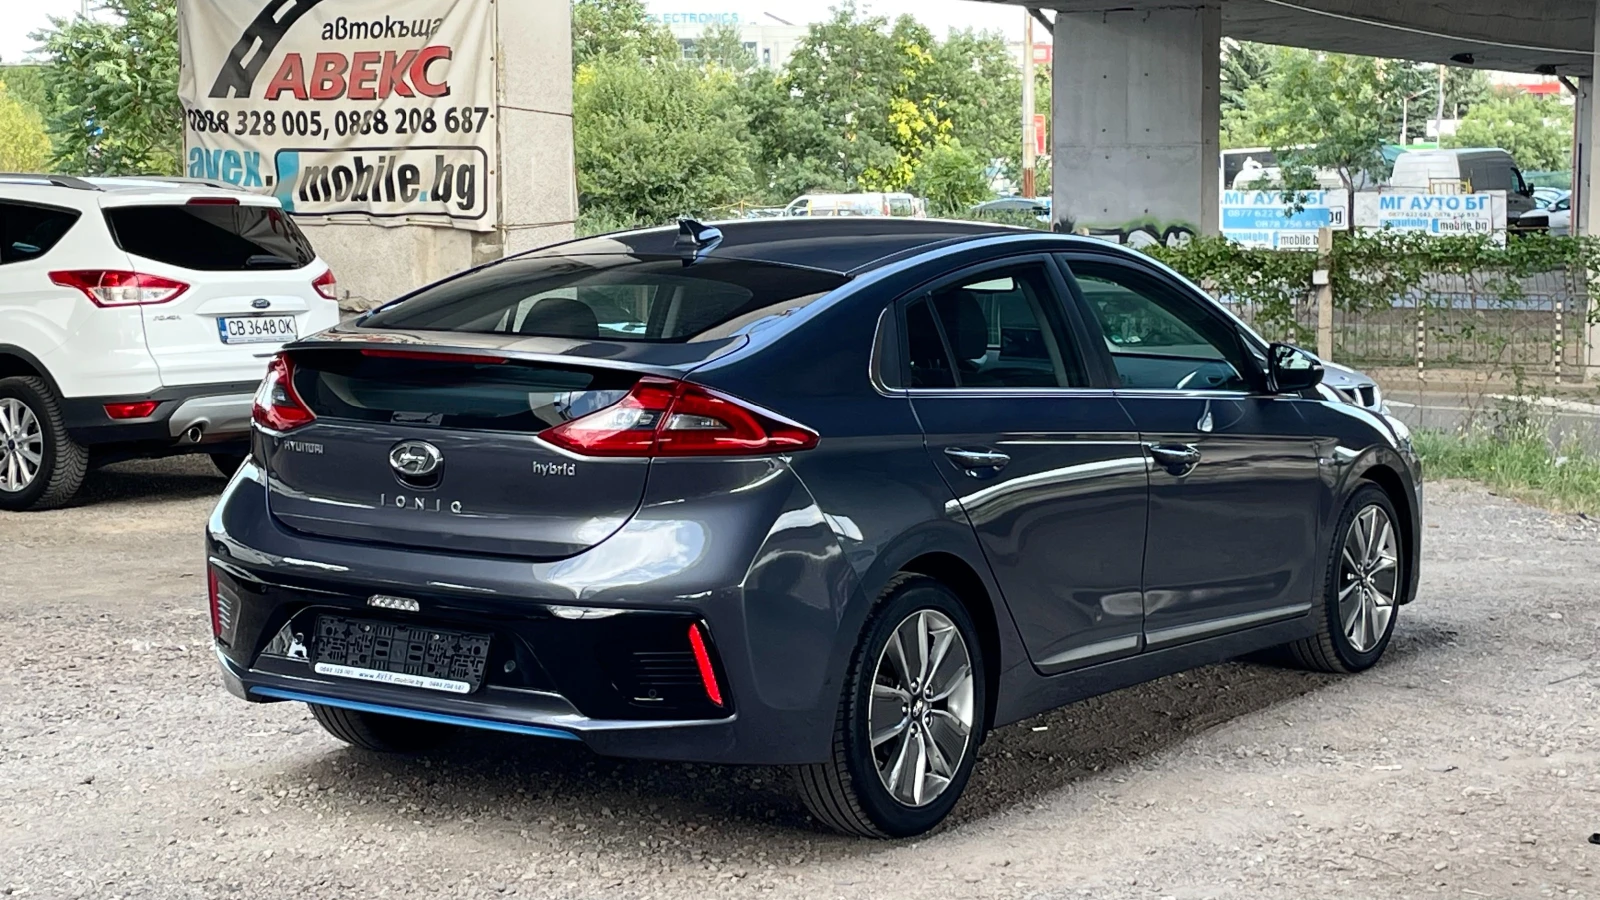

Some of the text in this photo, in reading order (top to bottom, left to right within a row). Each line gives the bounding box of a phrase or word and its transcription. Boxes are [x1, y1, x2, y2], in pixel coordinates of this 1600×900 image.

[645, 12, 739, 24] ECTRONICS
[264, 45, 452, 101] АВЕКС
[187, 107, 489, 140] 0888 328 005, 0888 208 687
[1253, 191, 1300, 206] АУ
[1379, 196, 1489, 211] МГ АУТО БГ
[228, 320, 246, 336] CB
[247, 319, 277, 335] 3648
[532, 461, 576, 477] hybrid
[379, 493, 463, 514] IONIQ
